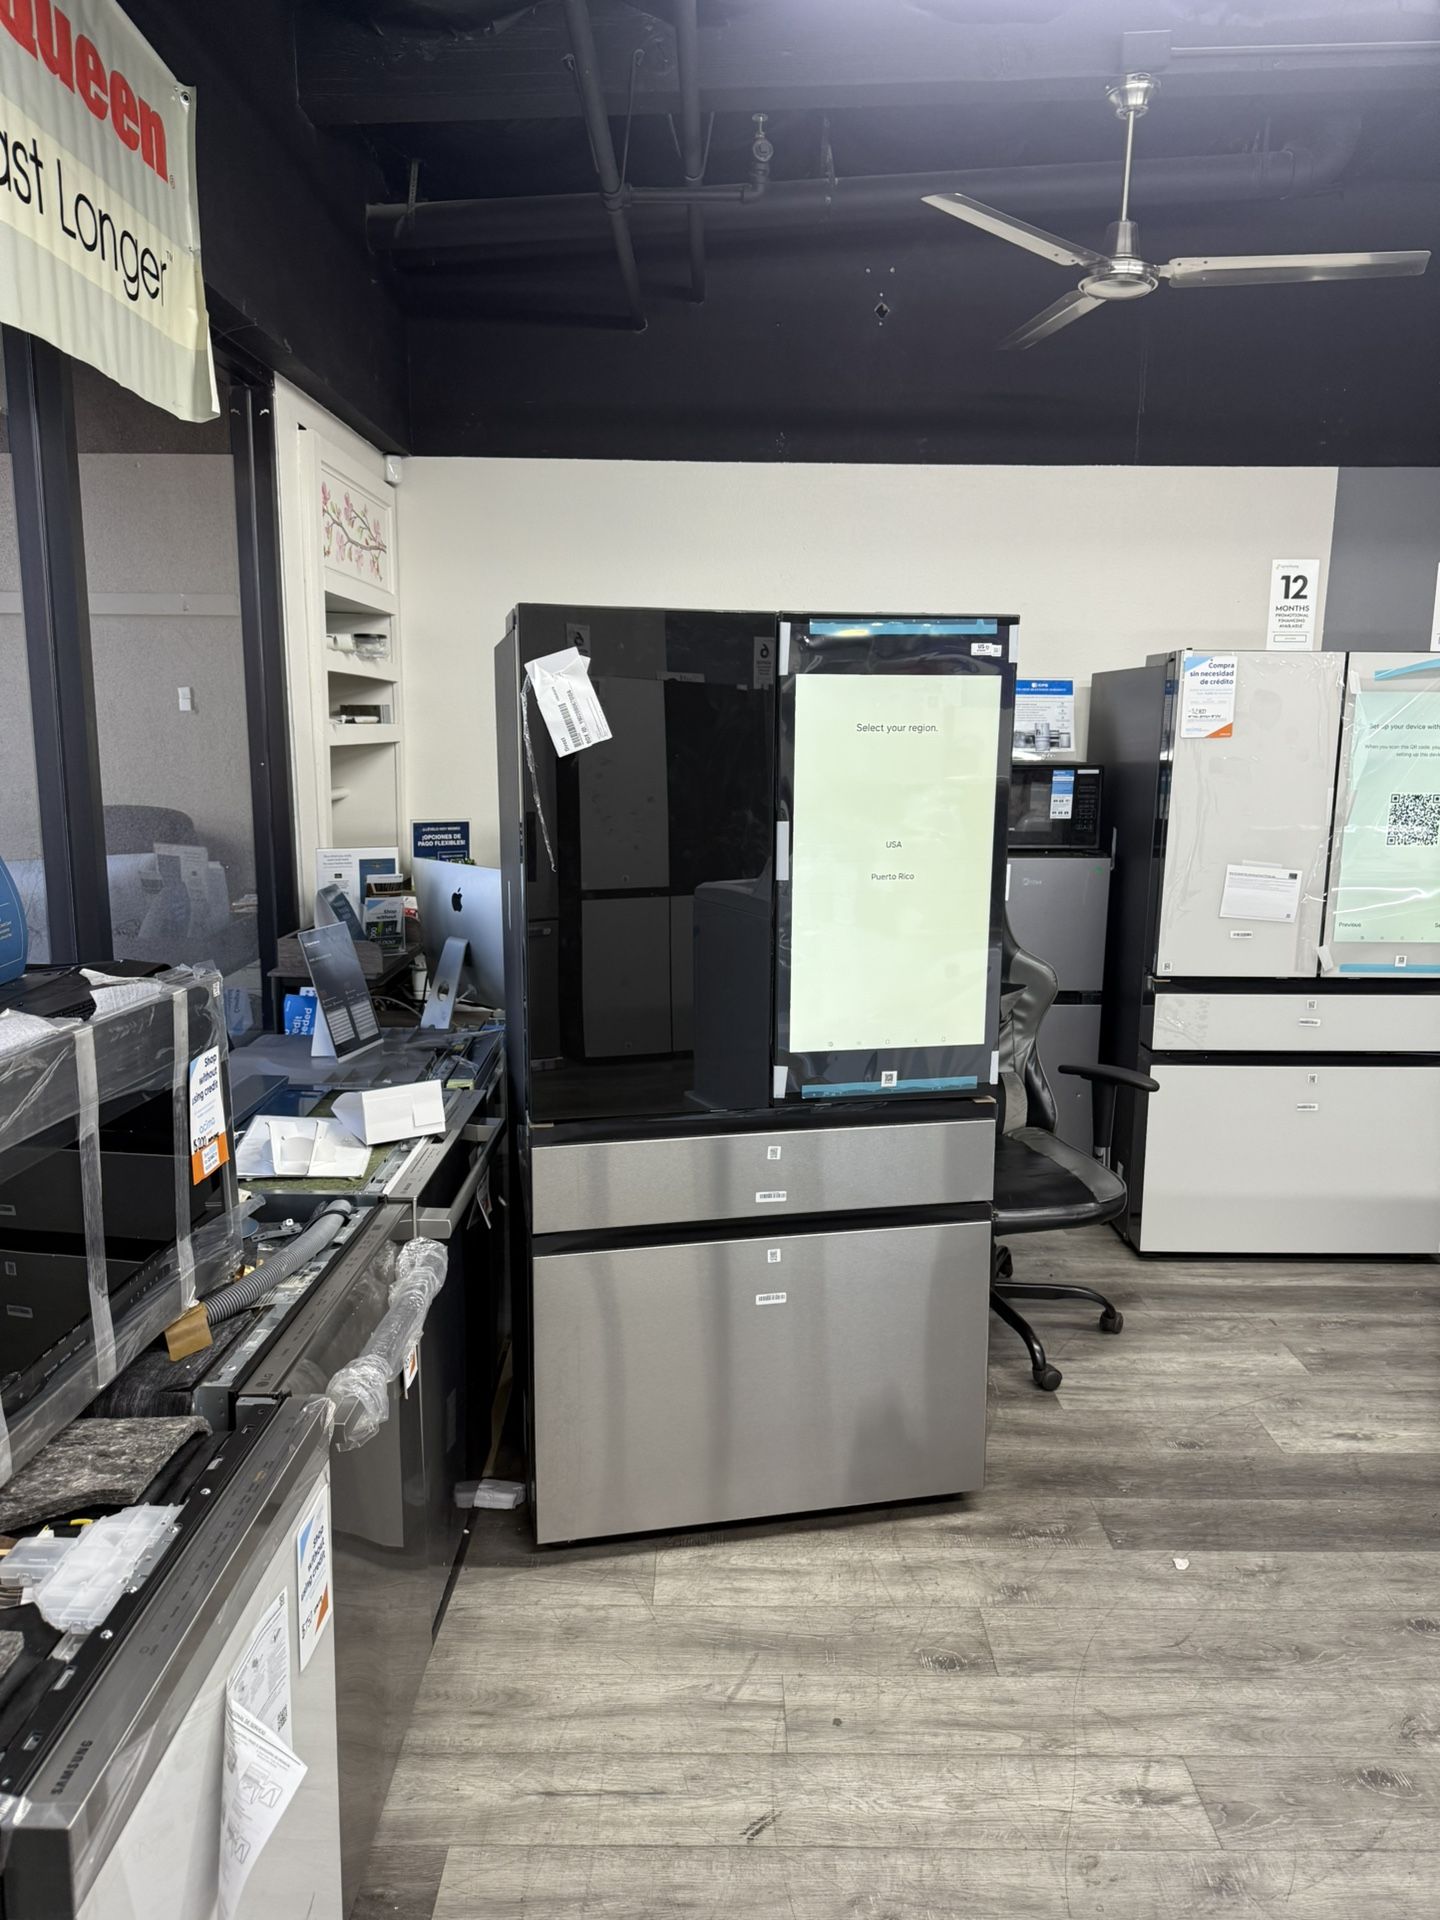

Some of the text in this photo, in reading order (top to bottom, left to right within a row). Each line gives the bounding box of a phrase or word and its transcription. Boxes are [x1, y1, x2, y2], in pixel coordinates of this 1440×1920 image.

[57, 159, 168, 306] Longer
[1280, 575, 1309, 600] 12
[856, 723, 939, 734] Select your region.
[204, 1054, 217, 1067] Shop
[199, 1067, 218, 1085] without
[204, 1080, 218, 1096] credit
[51, 1740, 93, 1795] SAMSUNG
